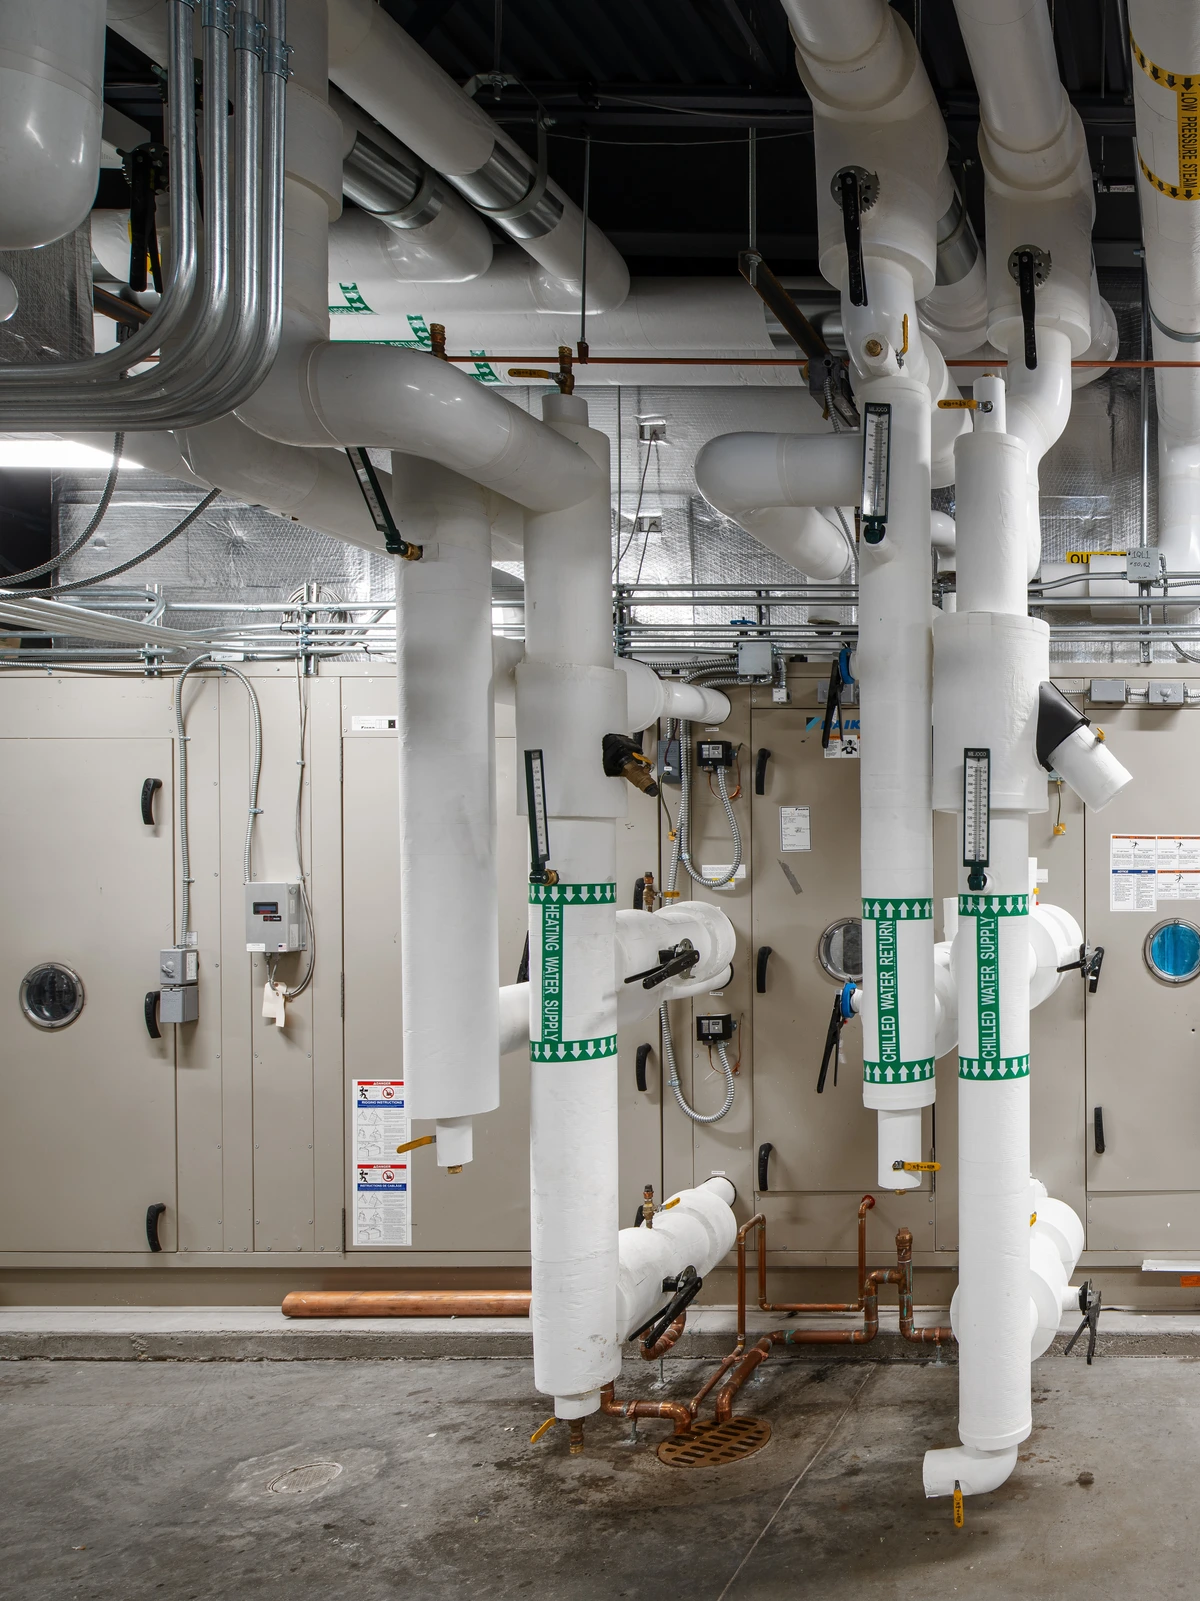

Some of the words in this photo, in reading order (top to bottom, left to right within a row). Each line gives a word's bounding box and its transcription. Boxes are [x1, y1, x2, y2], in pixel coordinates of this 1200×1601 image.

[1181, 92, 1198, 112] LOW
[1182, 117, 1198, 159] PRESSURE
[1183, 164, 1198, 188] STEAM
[545, 904, 560, 951] HEATING
[879, 920, 894, 966] RETURN
[979, 916, 995, 960] SUPPLY
[544, 956, 560, 994] WATER
[880, 971, 895, 1011] WATER
[980, 965, 996, 1006] WATER
[544, 998, 559, 1042] SUPPLY
[881, 1015, 897, 1062] CHILLED
[981, 1011, 997, 1060] CHILLED
